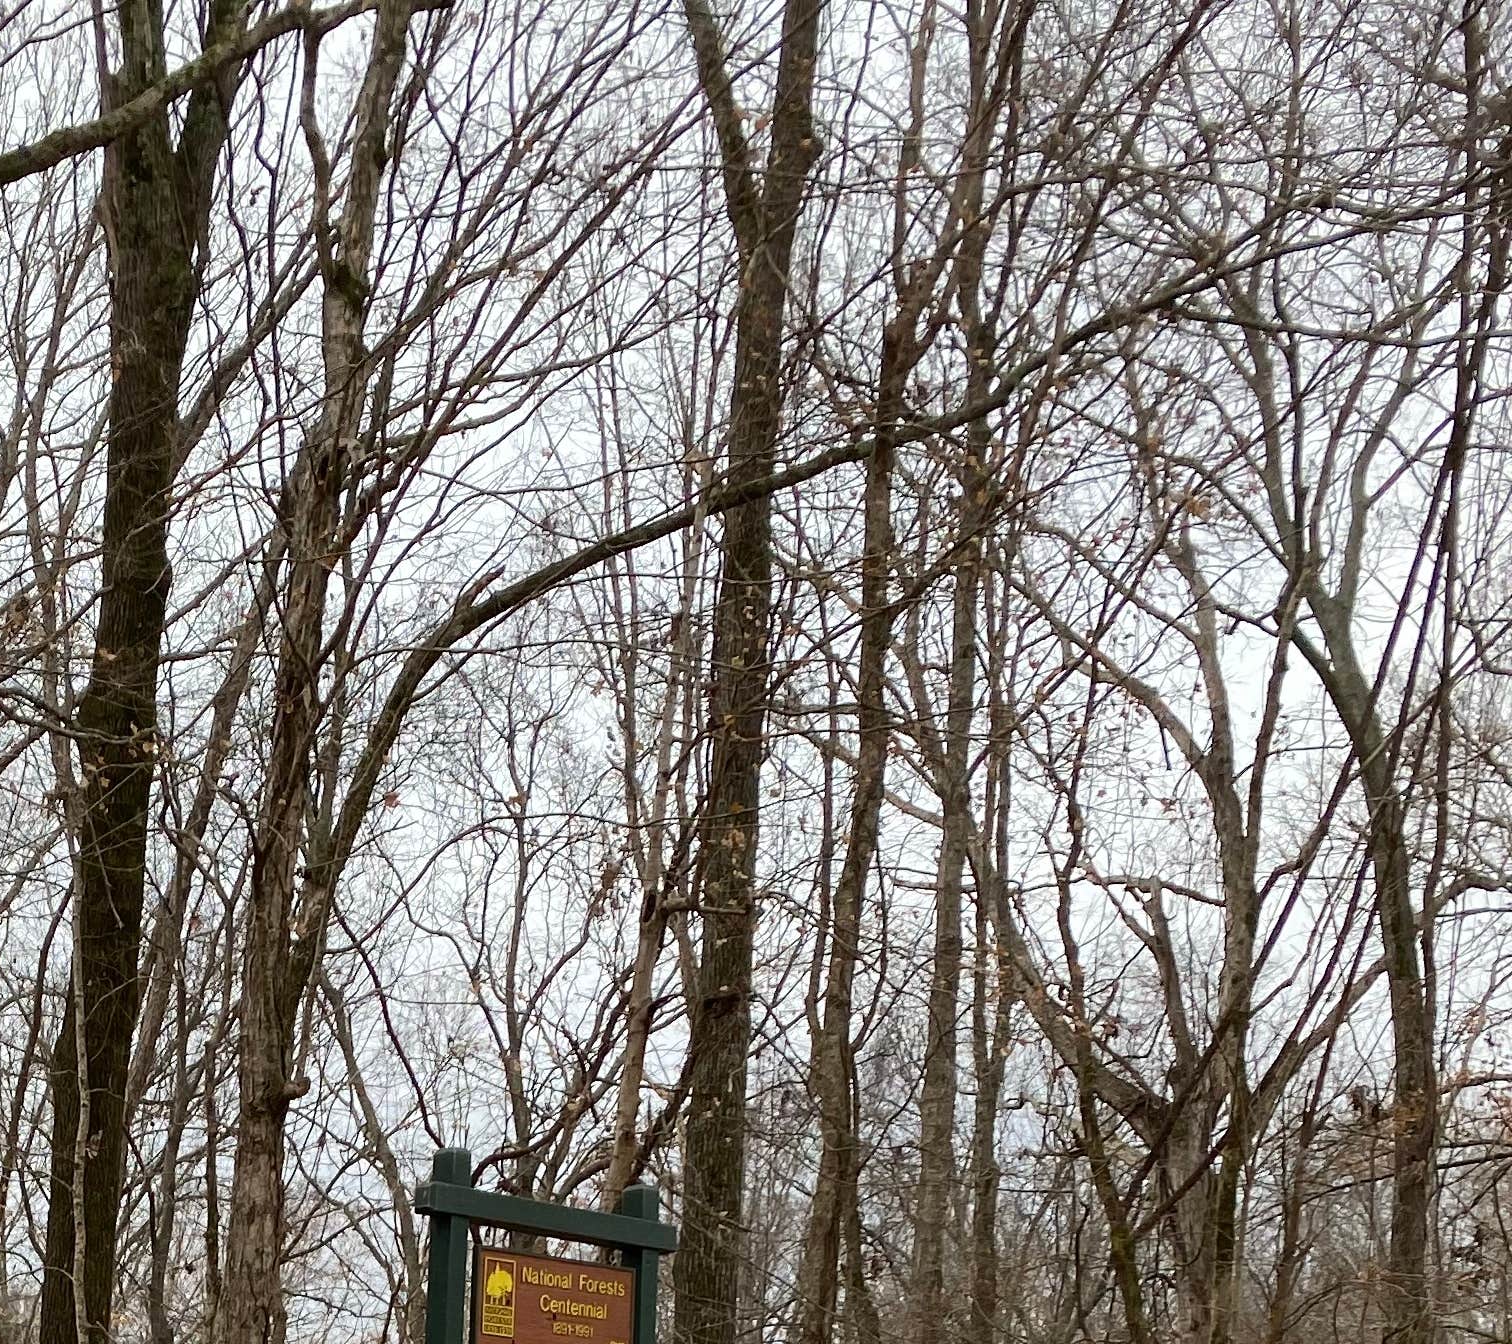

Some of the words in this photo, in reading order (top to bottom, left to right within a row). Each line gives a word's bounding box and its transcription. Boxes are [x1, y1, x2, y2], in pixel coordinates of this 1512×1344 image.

[522, 1266, 572, 1289] National
[579, 1274, 626, 1297] Forests
[539, 1294, 608, 1319] Centennial
